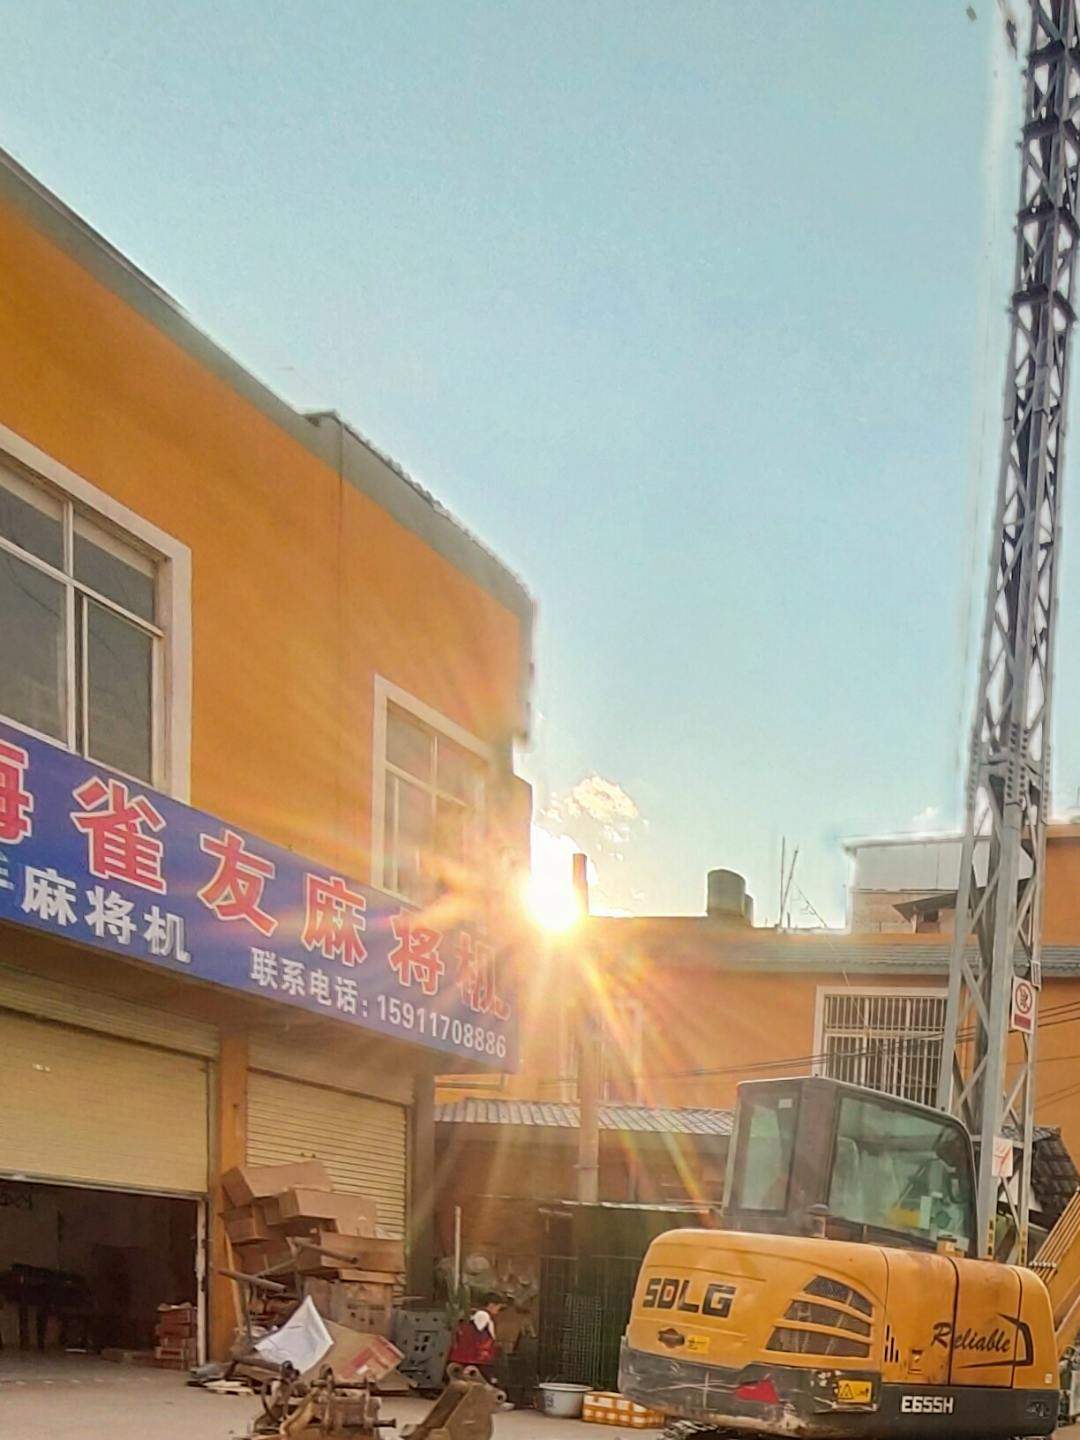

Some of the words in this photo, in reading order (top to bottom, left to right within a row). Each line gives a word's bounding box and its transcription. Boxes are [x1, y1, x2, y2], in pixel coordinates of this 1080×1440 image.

[0, 853, 191, 964] 麻将机
[641, 1278, 736, 1318] SDLG
[930, 1321, 1011, 1352] Reliable
